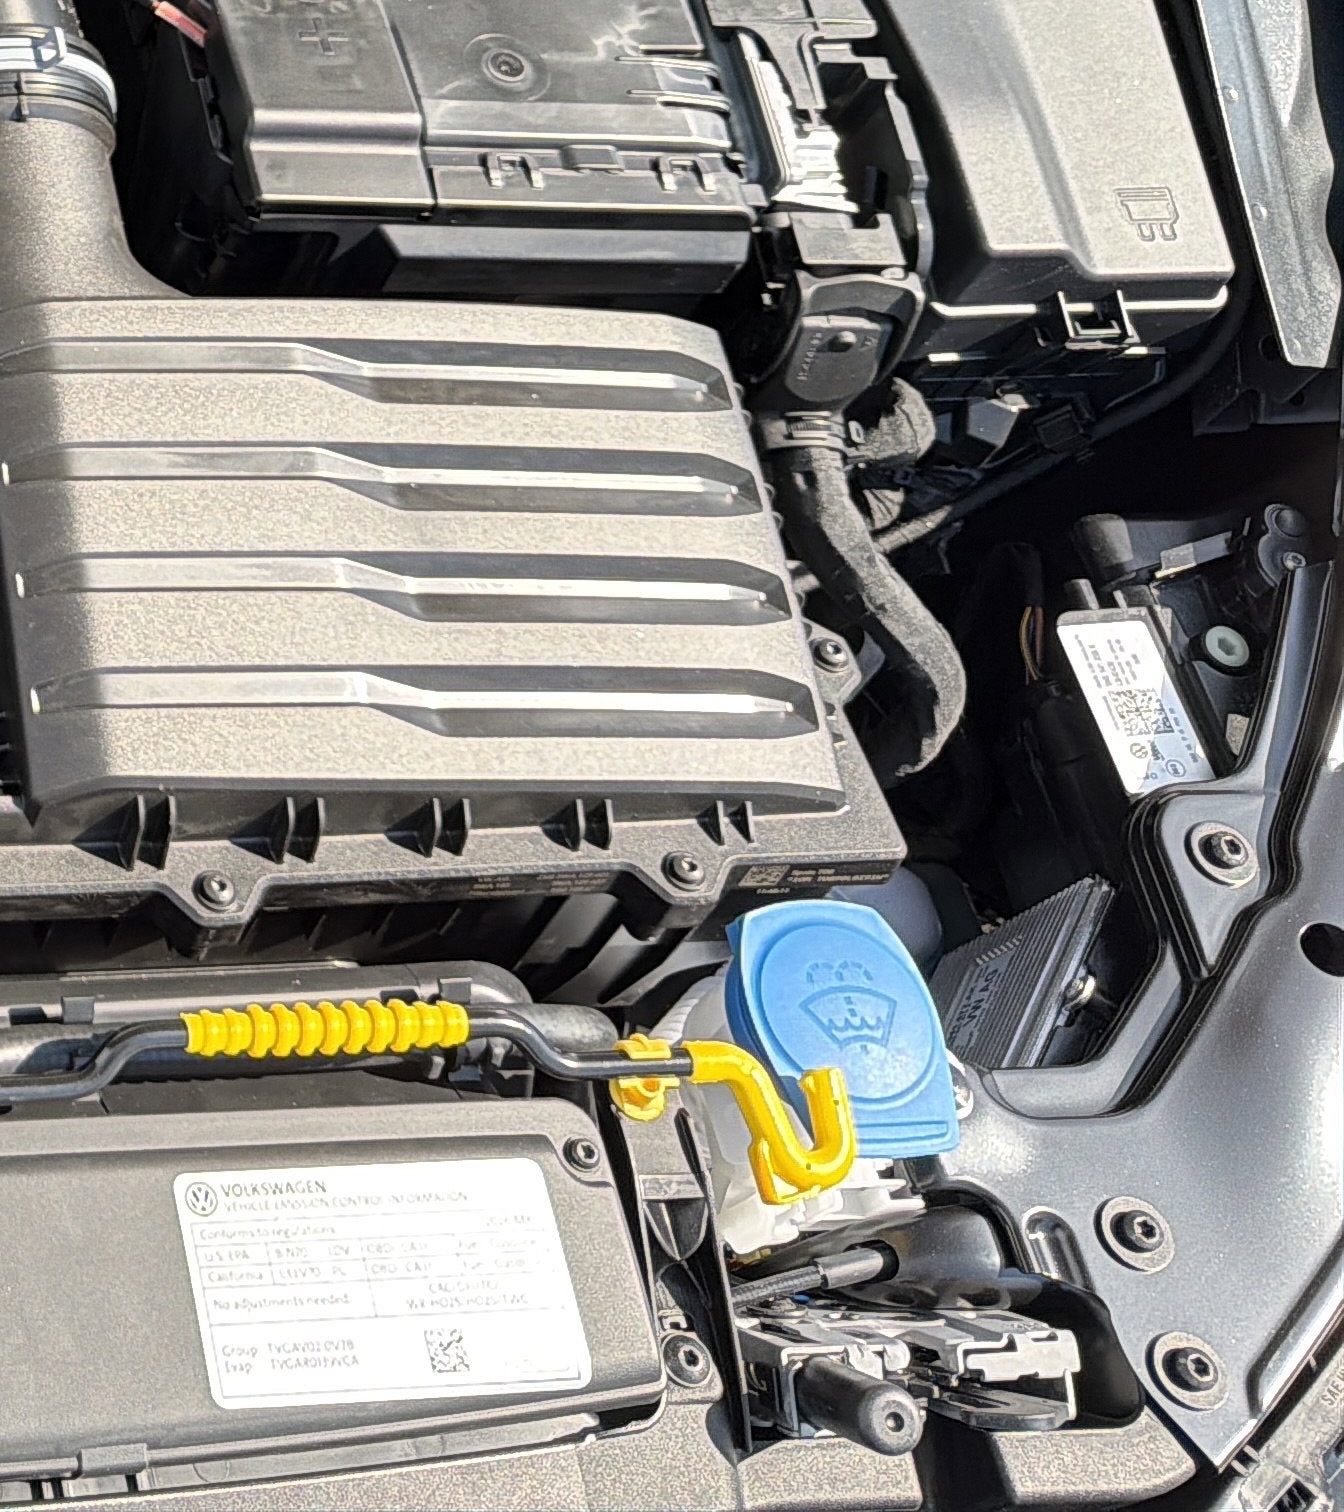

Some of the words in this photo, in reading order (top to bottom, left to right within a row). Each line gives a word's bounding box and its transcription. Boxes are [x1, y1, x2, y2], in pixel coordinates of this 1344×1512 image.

[220, 1180, 327, 1198] VOLKSWAGEN
[224, 1199, 270, 1213] VEHICLE
[274, 1197, 329, 1211] EMISSION
[332, 1195, 383, 1207] CONTROL
